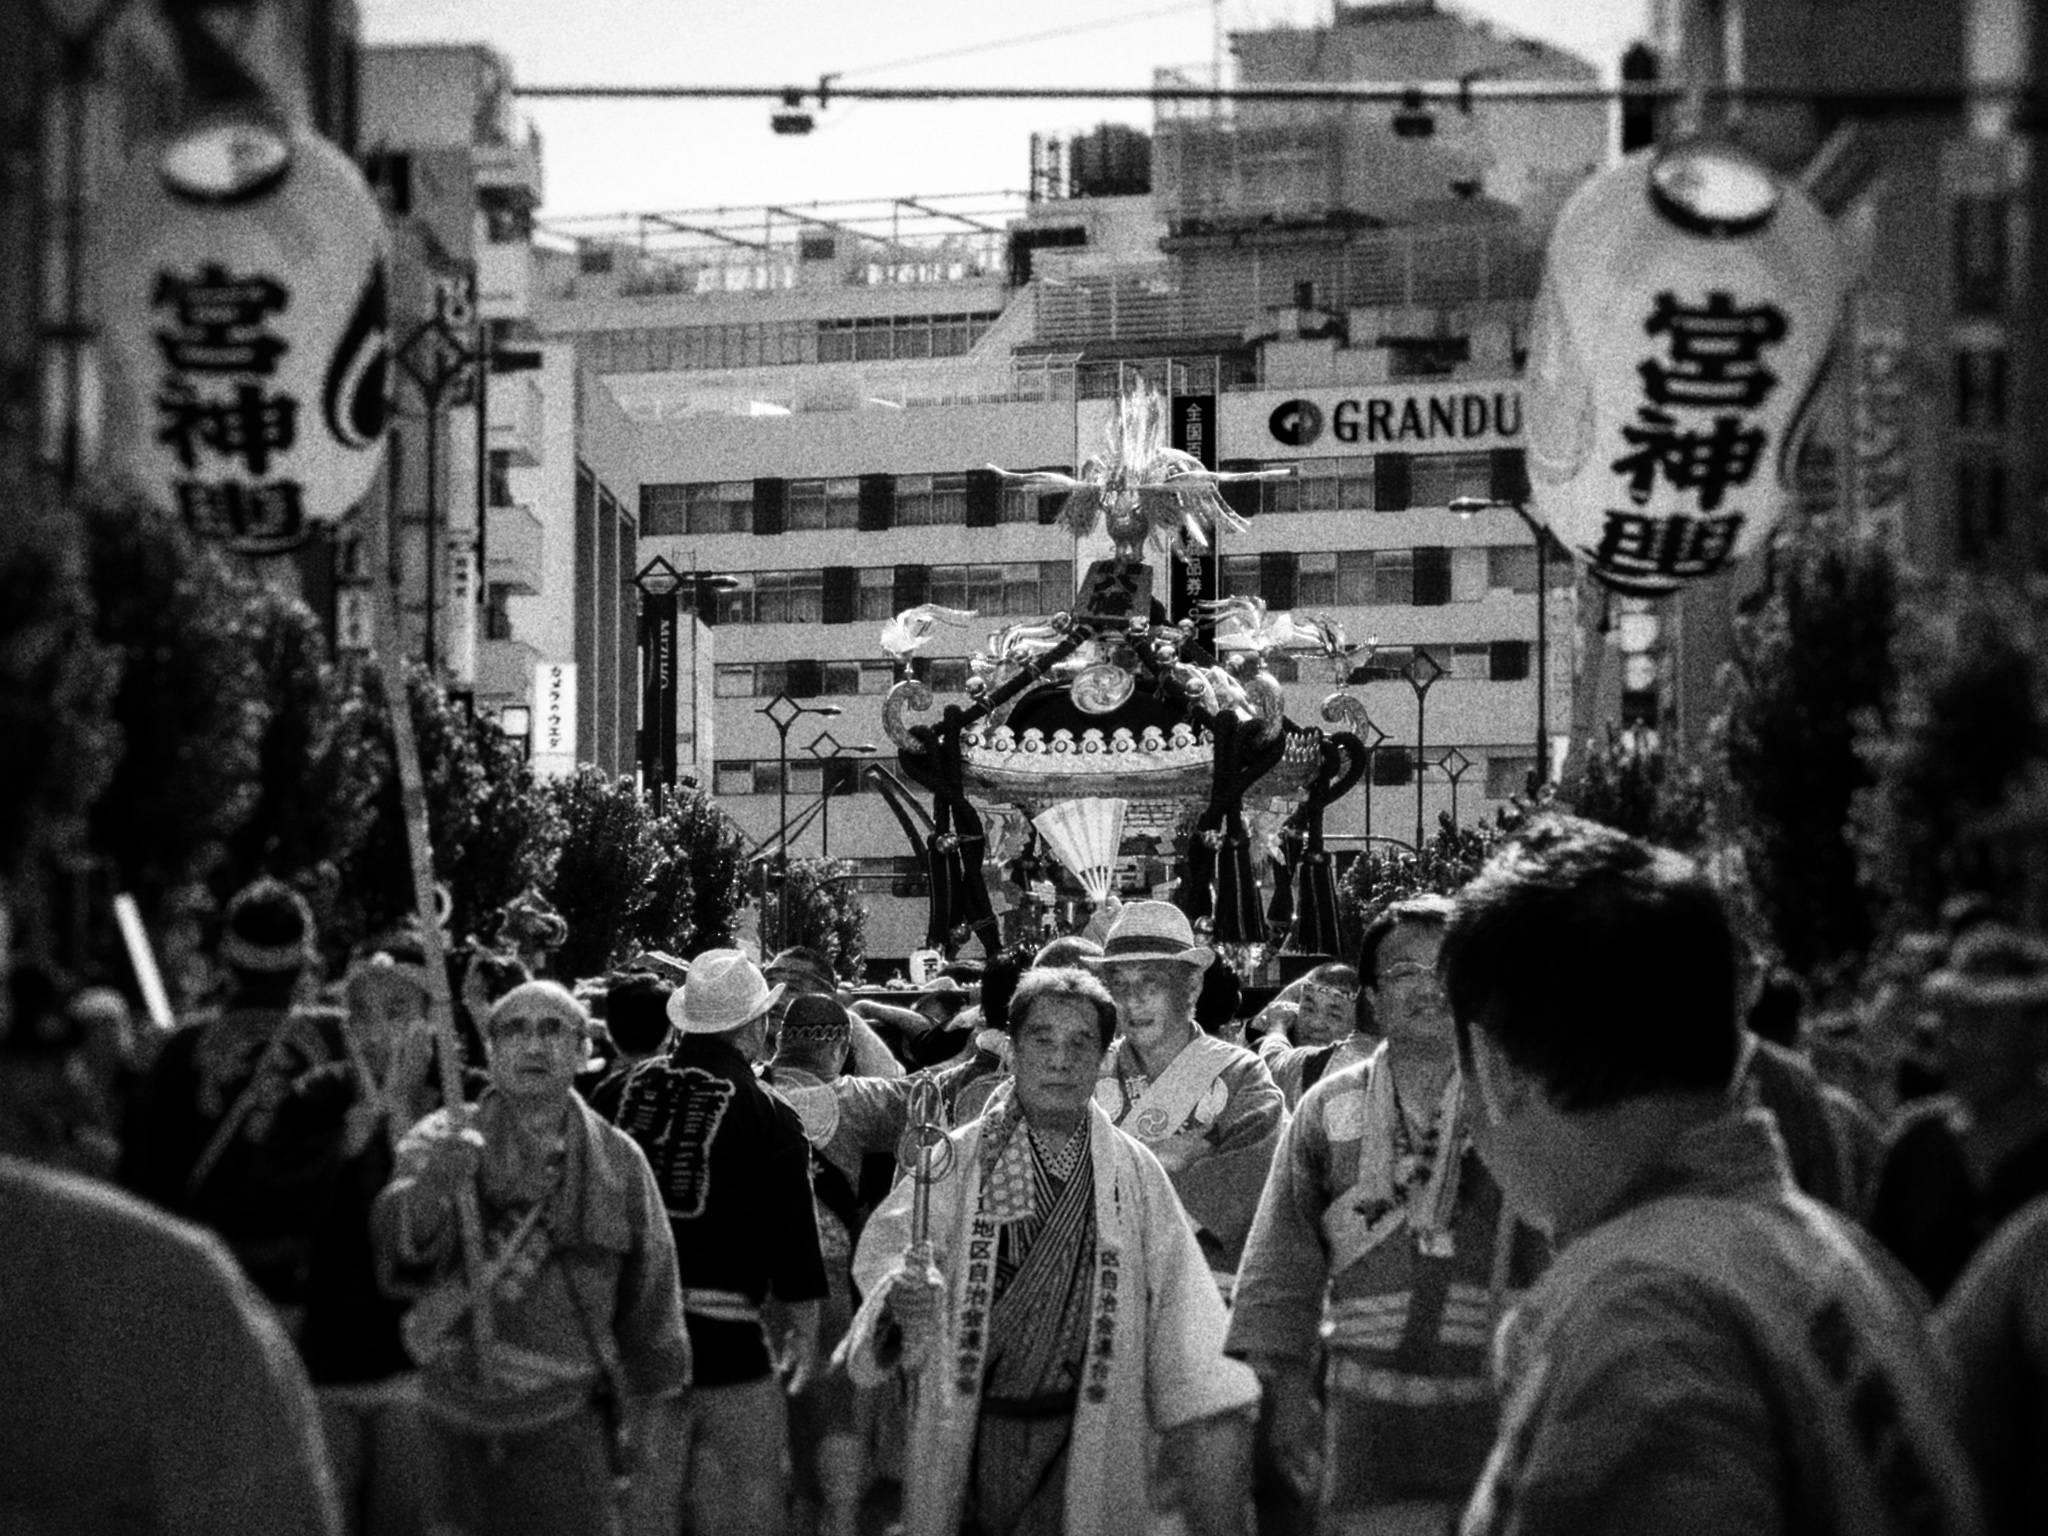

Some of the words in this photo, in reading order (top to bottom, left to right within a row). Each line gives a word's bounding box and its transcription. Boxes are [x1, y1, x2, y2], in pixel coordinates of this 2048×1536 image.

[1333, 393, 1523, 442] GRANDU
[956, 1197, 995, 1396] 地区自治会連合会
